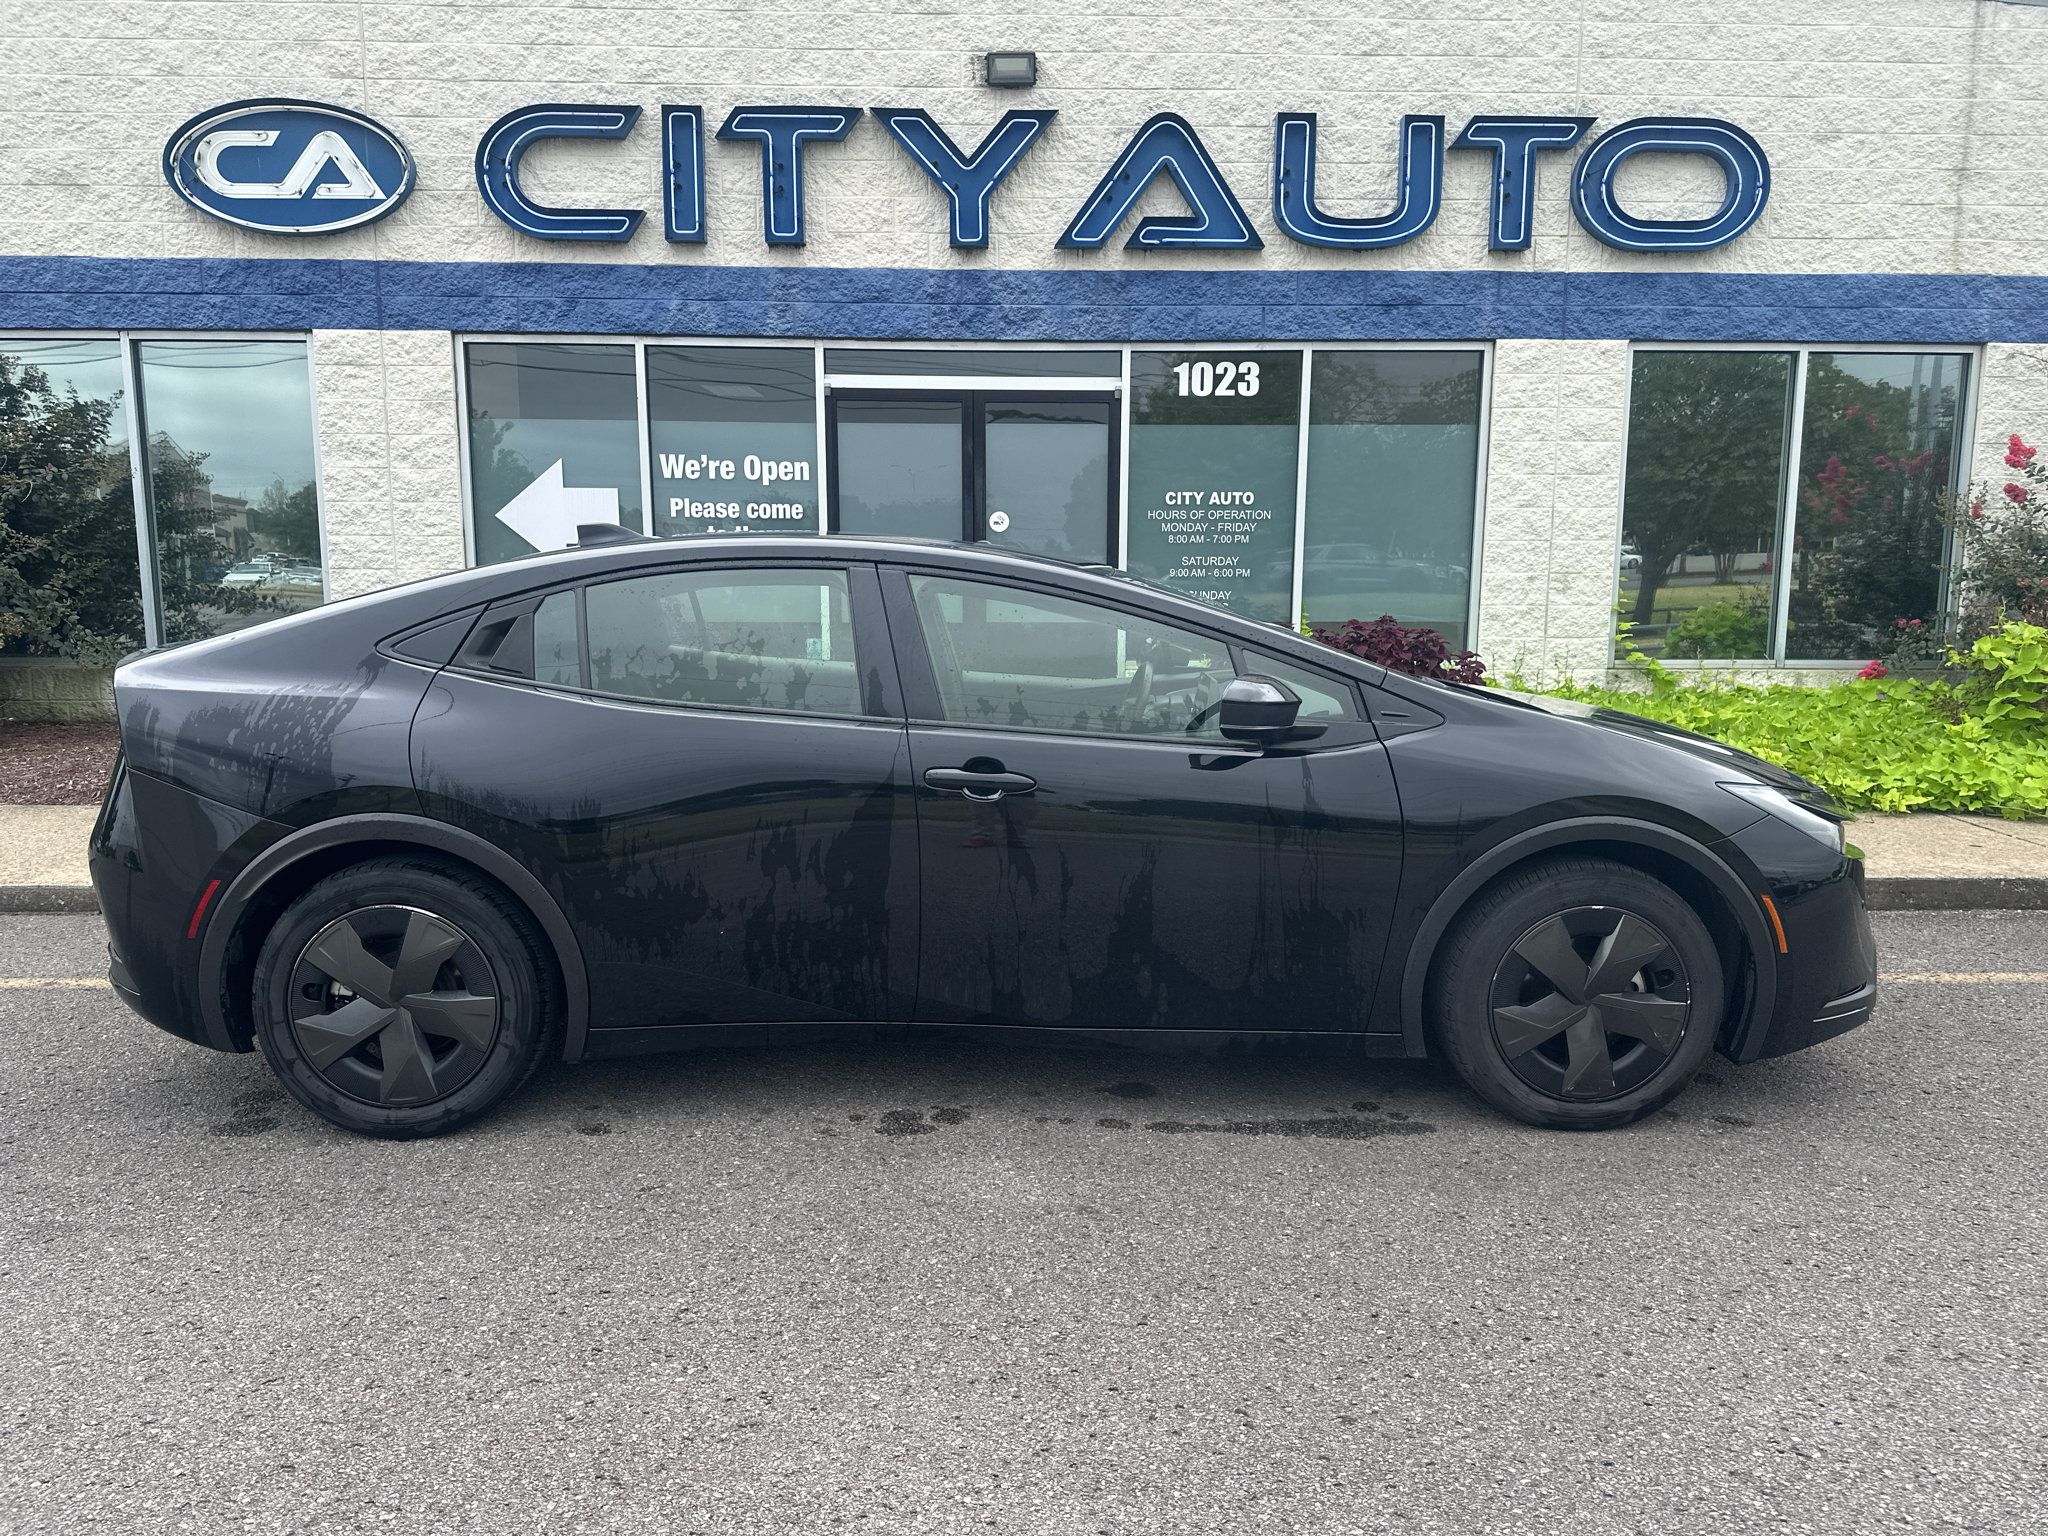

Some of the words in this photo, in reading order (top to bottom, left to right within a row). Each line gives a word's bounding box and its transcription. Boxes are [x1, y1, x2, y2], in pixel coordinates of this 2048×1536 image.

[194, 129, 387, 200] CA
[475, 103, 1059, 250] CITY
[1055, 112, 1772, 253] AUTO
[1173, 361, 1260, 397] 1023
[659, 453, 735, 480] We're
[743, 454, 810, 486] Open
[1165, 491, 1205, 506] CITY
[1208, 491, 1255, 506] AUTO
[669, 497, 740, 519] Please
[746, 502, 804, 520] come
[1147, 510, 1187, 520] HOURS
[1189, 510, 1205, 520] OF
[1207, 510, 1272, 520] OPERATION
[1161, 522, 1209, 532] MONDAY
[1217, 522, 1257, 532] FRIDAY
[1168, 534, 1188, 544] 8:00
[1189, 534, 1205, 544] AM
[1212, 534, 1232, 544] 7:00
[1234, 534, 1250, 544] PM
[1181, 556, 1240, 566] SATURDAY
[1169, 568, 1189, 578] 9:00
[1190, 568, 1206, 578] AM
[1213, 568, 1234, 578] 6:00
[1235, 568, 1251, 578] PM
[1189, 590, 1232, 600] UNDAY
